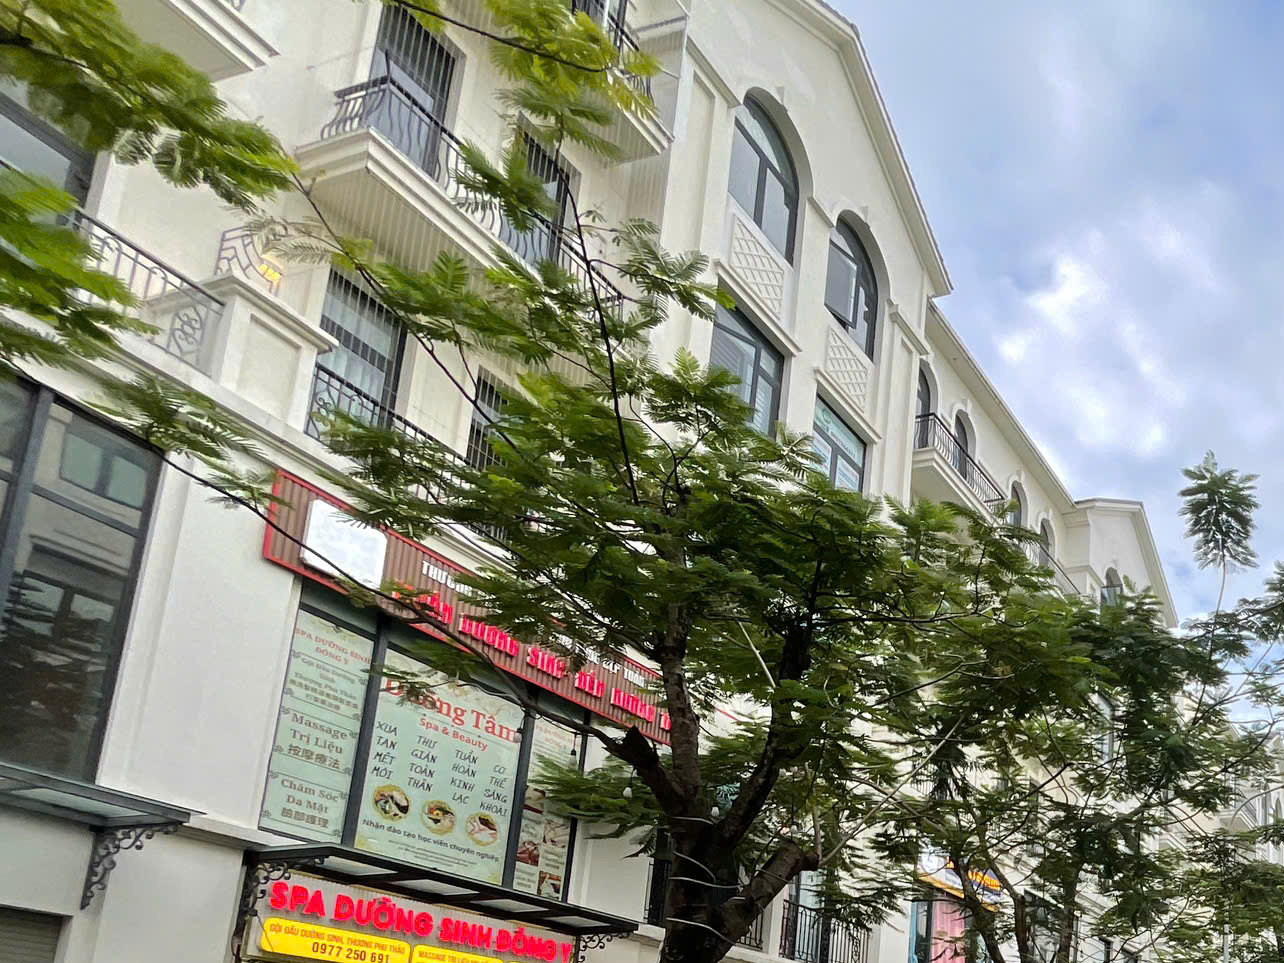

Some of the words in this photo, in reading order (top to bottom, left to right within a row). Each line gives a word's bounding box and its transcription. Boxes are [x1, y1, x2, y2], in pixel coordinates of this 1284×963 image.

[292, 713, 348, 740] Massage
[376, 721, 398, 736] XUA
[419, 717, 440, 732] Spa
[441, 726, 450, 736] &
[452, 731, 489, 752] Beauty
[471, 709, 522, 743] Tâm
[314, 736, 343, 754] Liệu
[376, 736, 397, 750] TAN
[450, 777, 475, 792] KINH
[270, 881, 326, 917] SPA
[334, 893, 434, 937] DƯỠNG
[439, 917, 493, 949] SINH
[311, 941, 343, 956] 0977
[345, 947, 367, 962] 250
